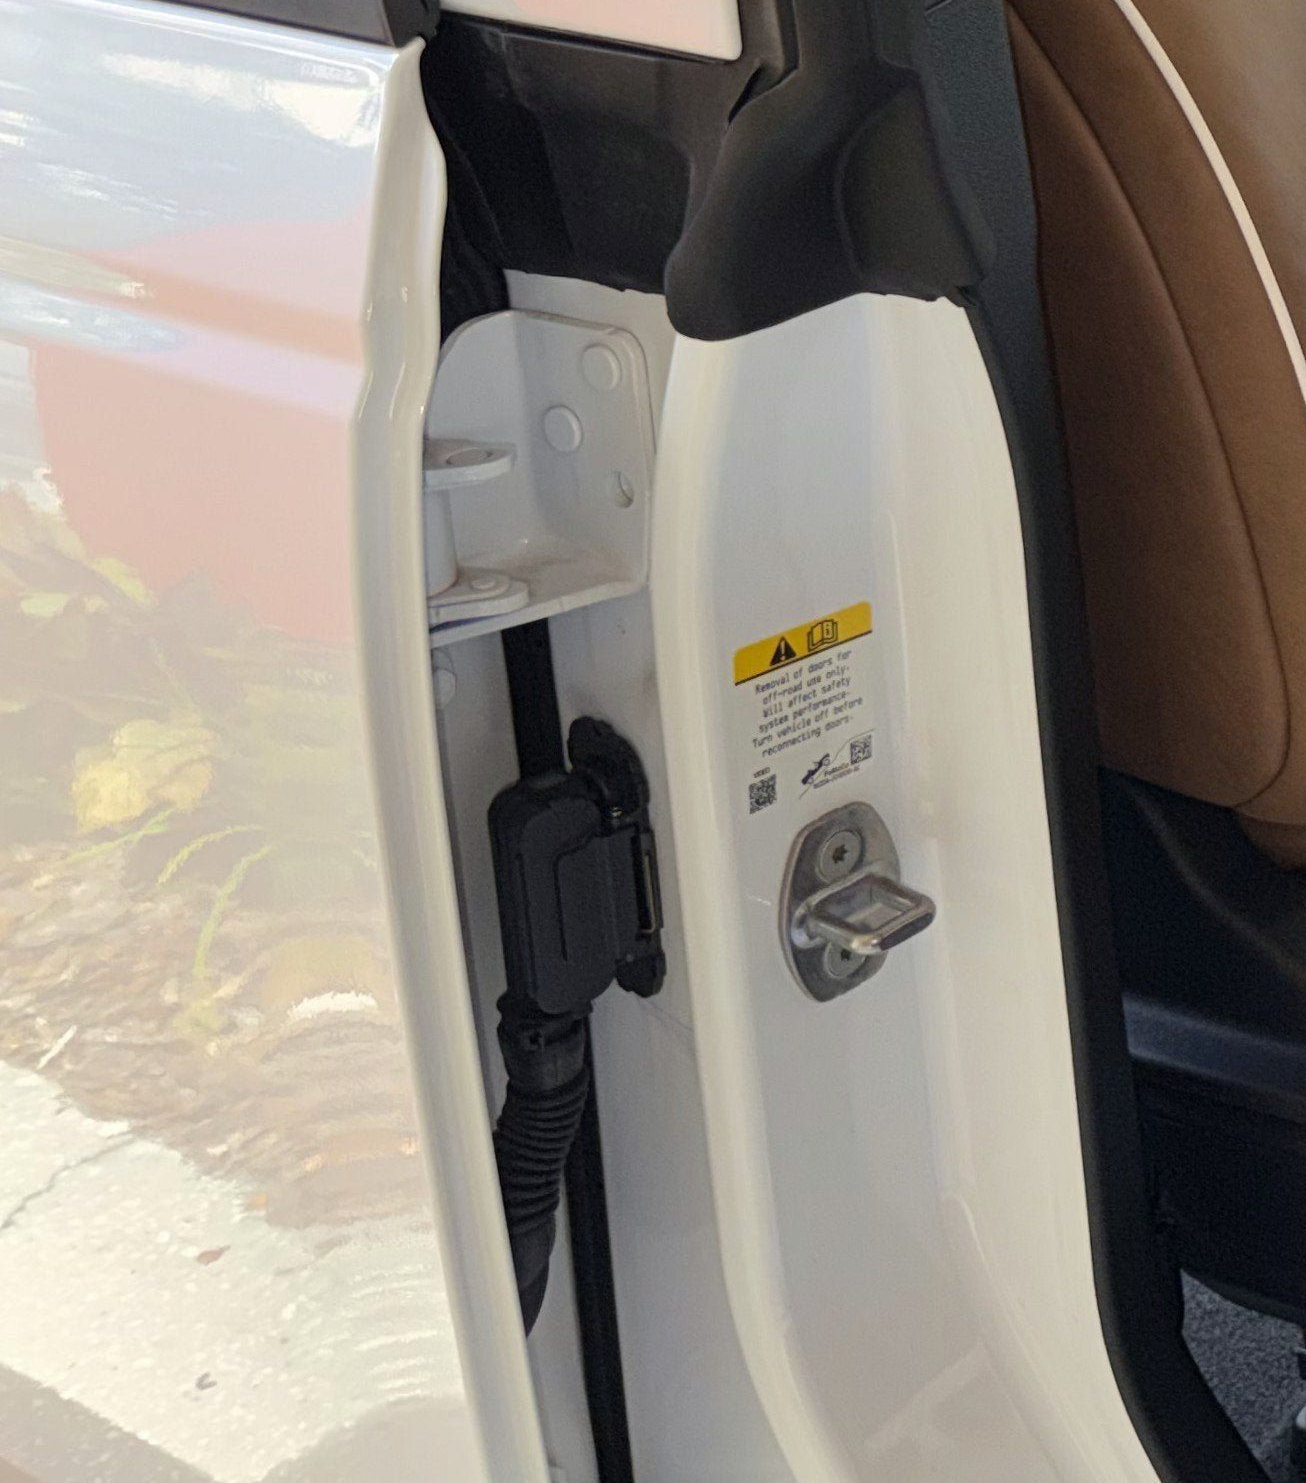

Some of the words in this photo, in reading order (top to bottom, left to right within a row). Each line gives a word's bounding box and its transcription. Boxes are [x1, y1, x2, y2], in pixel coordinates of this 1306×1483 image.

[755, 673, 790, 694] Removal
[793, 667, 803, 680] of
[808, 657, 833, 673] doors
[837, 650, 852, 661] for
[762, 682, 803, 705] off-road
[806, 676, 822, 687] use
[788, 689, 817, 708] affect
[821, 677, 851, 694] safety
[753, 735, 773, 748] Turn
[777, 718, 811, 737] vehicle
[815, 708, 829, 722] off
[834, 697, 863, 715] before
[759, 715, 789, 733] system
[762, 727, 821, 757] reconnecting
